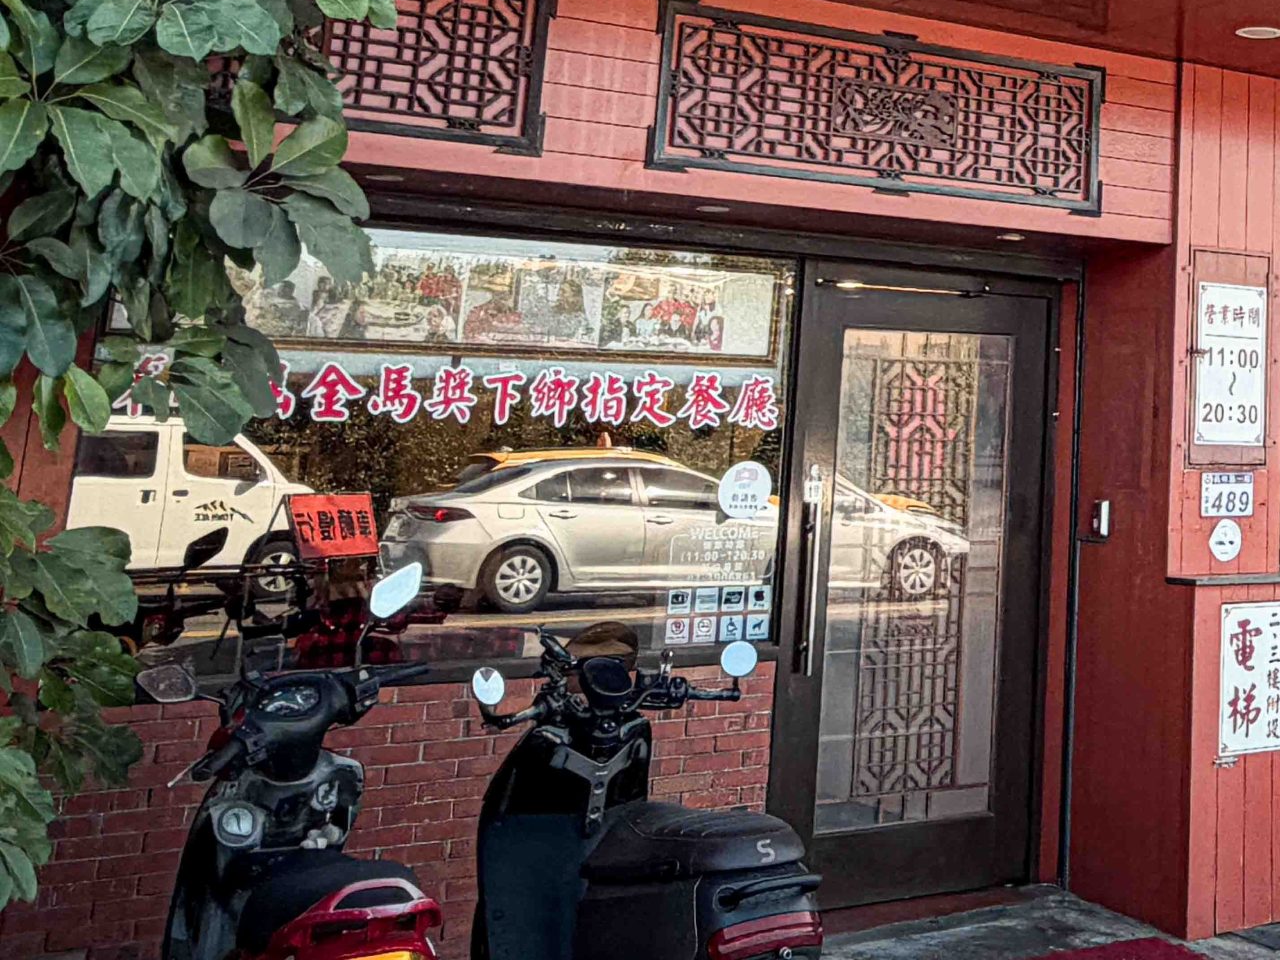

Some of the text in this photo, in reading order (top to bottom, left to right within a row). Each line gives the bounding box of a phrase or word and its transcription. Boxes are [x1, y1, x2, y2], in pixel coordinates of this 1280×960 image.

[1203, 303, 1261, 329] 營業時間
[1207, 346, 1260, 370] 11:00
[1201, 402, 1259, 425] 20:30
[1211, 491, 1250, 513] 489
[1227, 618, 1264, 739] 電梯
